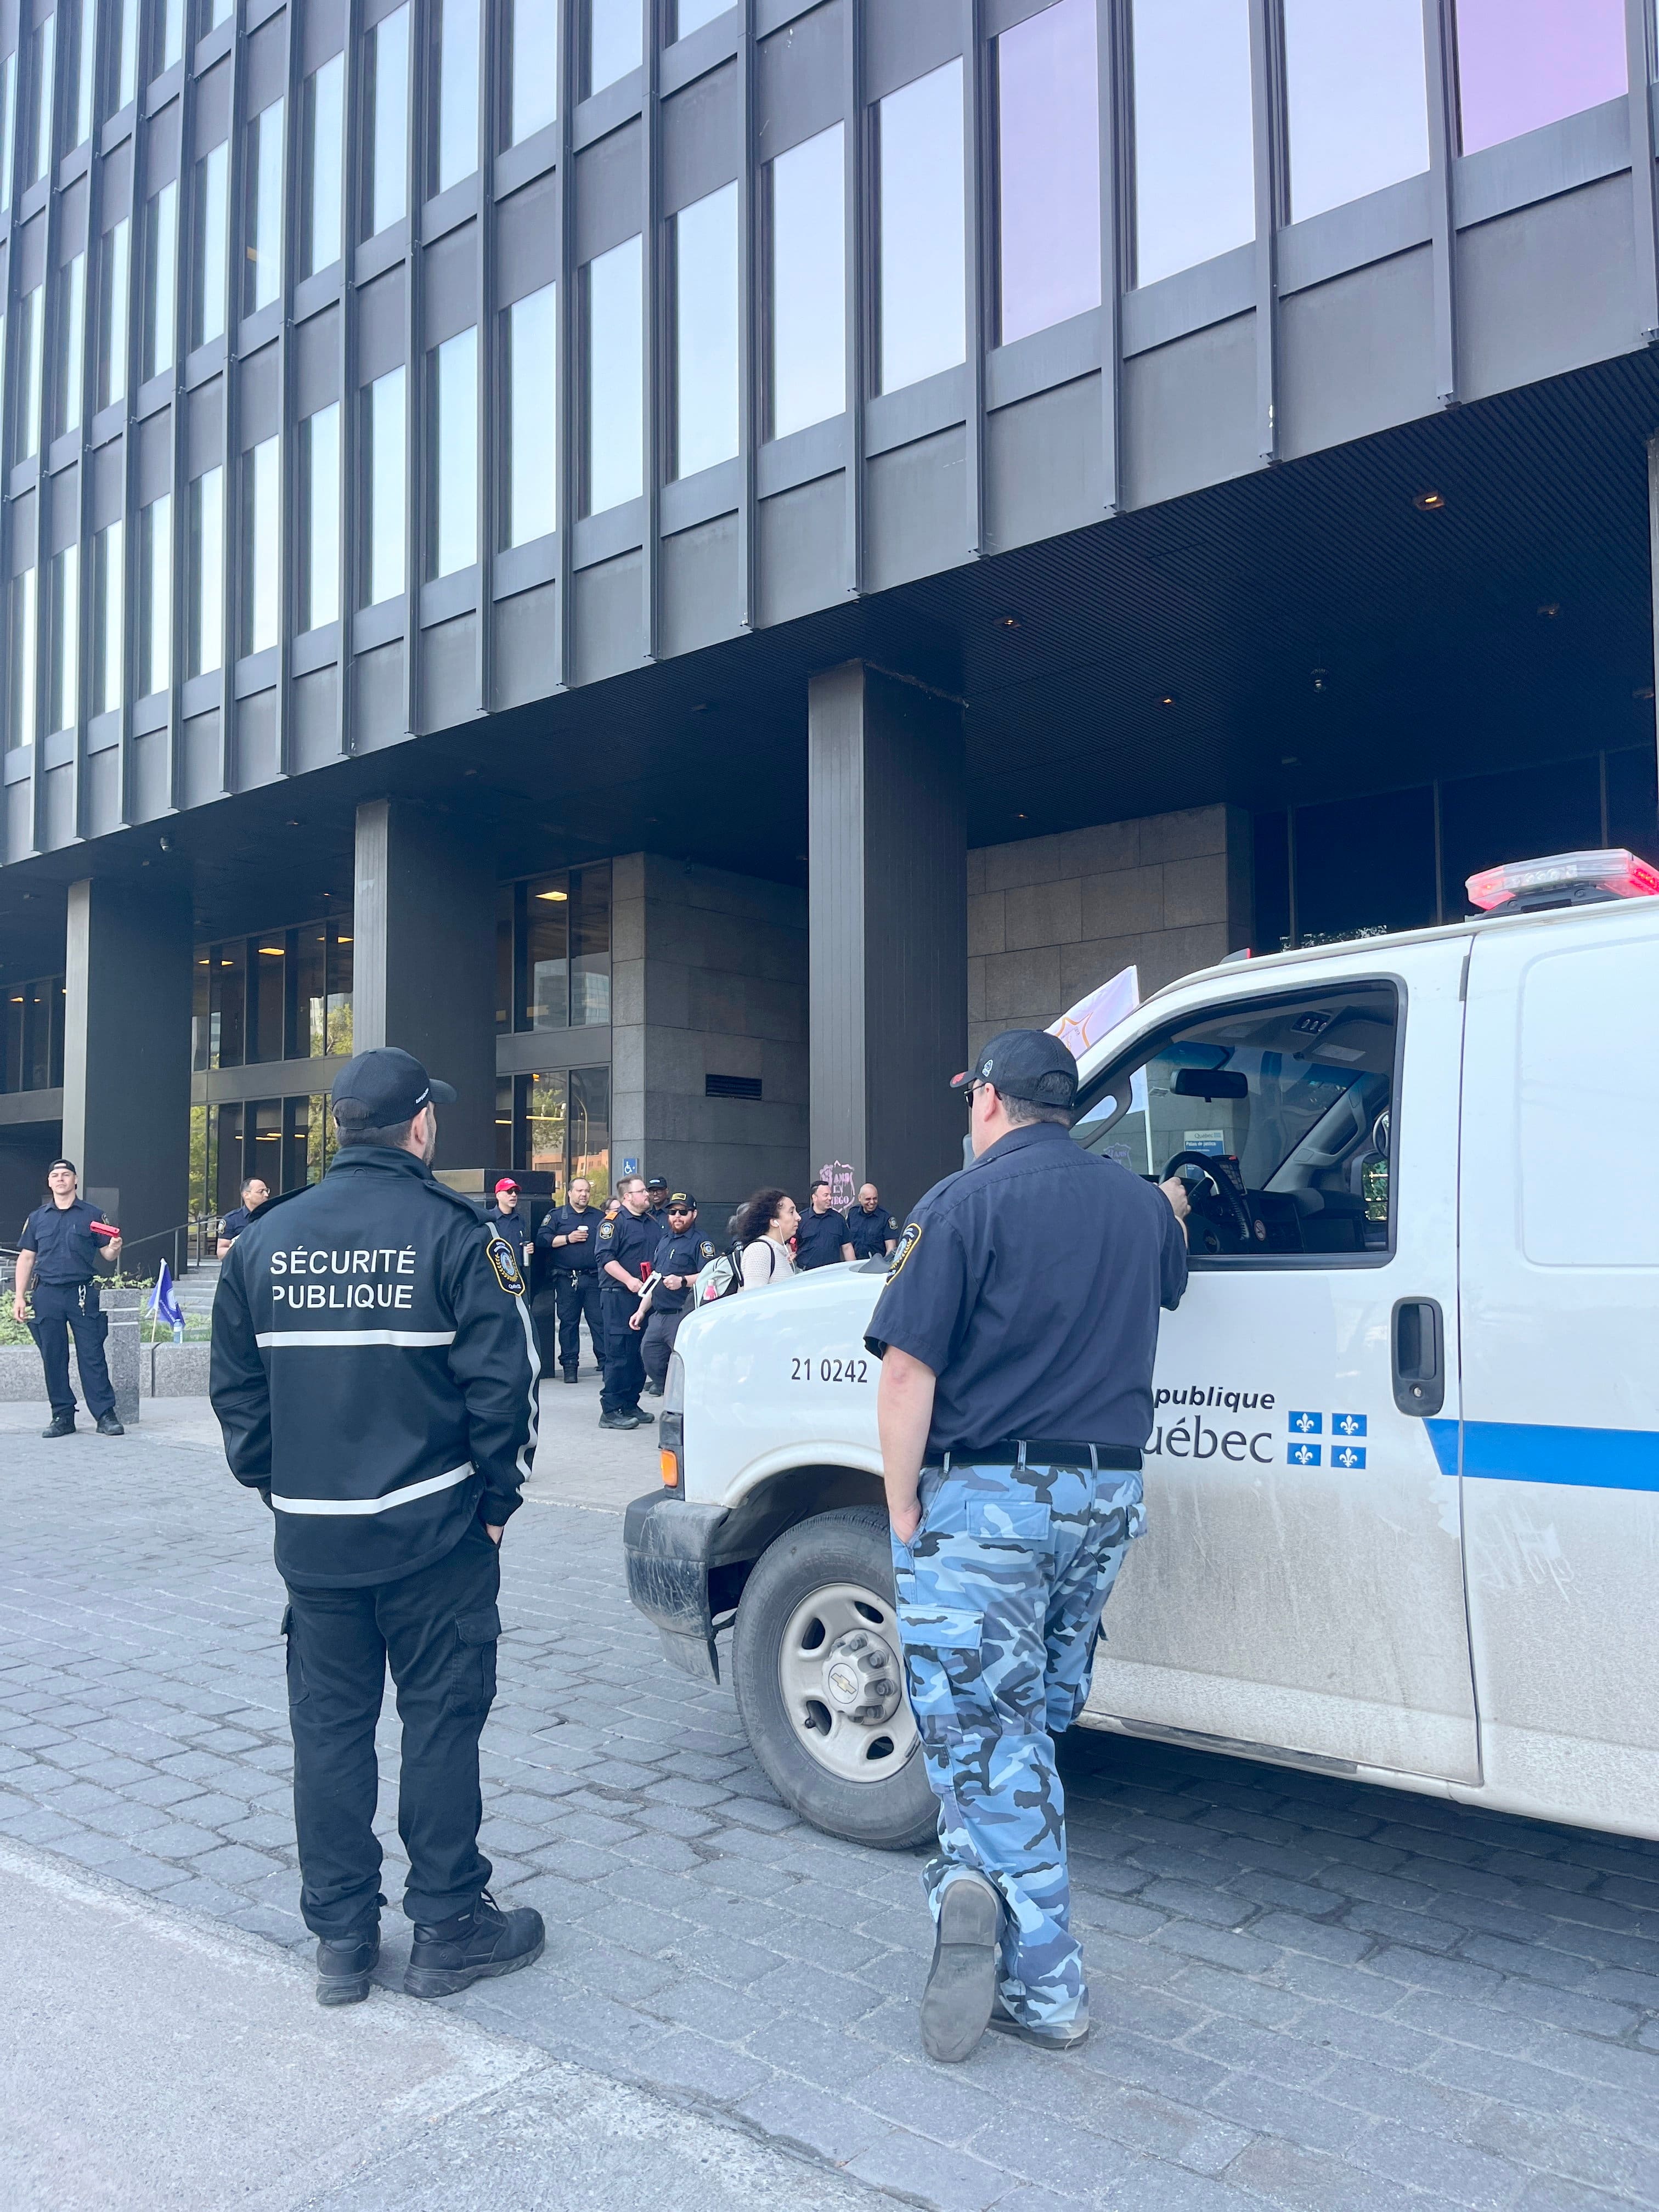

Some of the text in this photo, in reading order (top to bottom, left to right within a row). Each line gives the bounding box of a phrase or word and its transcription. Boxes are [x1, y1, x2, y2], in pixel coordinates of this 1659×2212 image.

[270, 1245, 416, 1274] SÉCURITÉ
[272, 1283, 414, 1309] PUBLIQUE
[792, 1358, 867, 1383] 21 0242
[1154, 1385, 1275, 1413] publique
[1143, 1414, 1274, 1463] uébec
